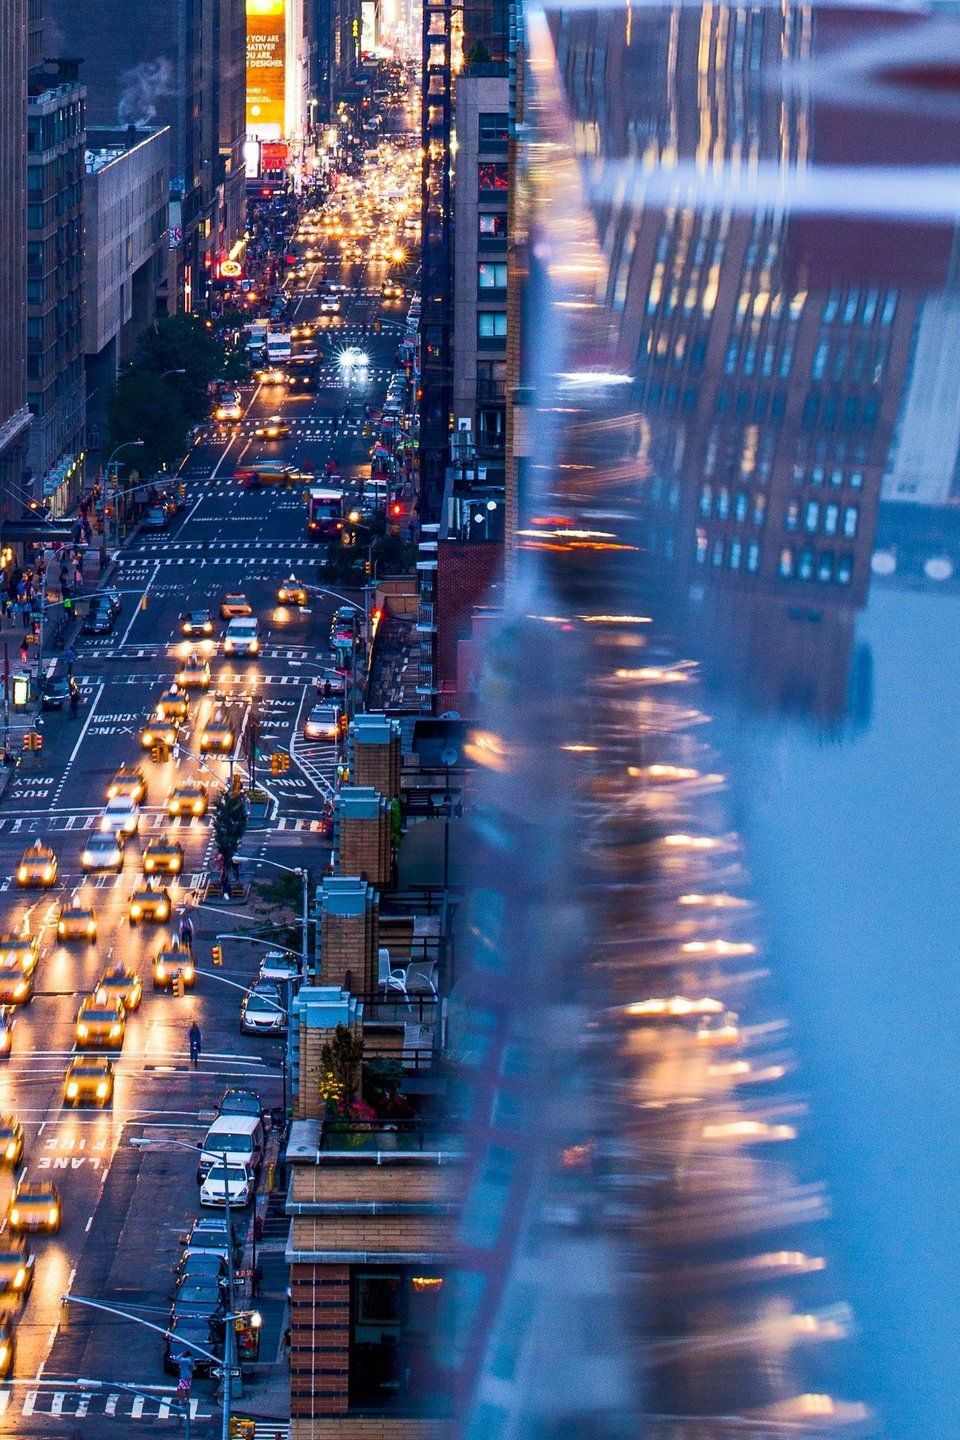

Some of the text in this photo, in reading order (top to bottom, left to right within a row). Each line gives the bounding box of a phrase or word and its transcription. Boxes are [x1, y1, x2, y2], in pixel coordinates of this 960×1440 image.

[13, 777, 54, 786] ONLY
[264, 778, 306, 787] ONLY
[11, 789, 50, 798] BUS
[38, 1157, 102, 1169] LANE
